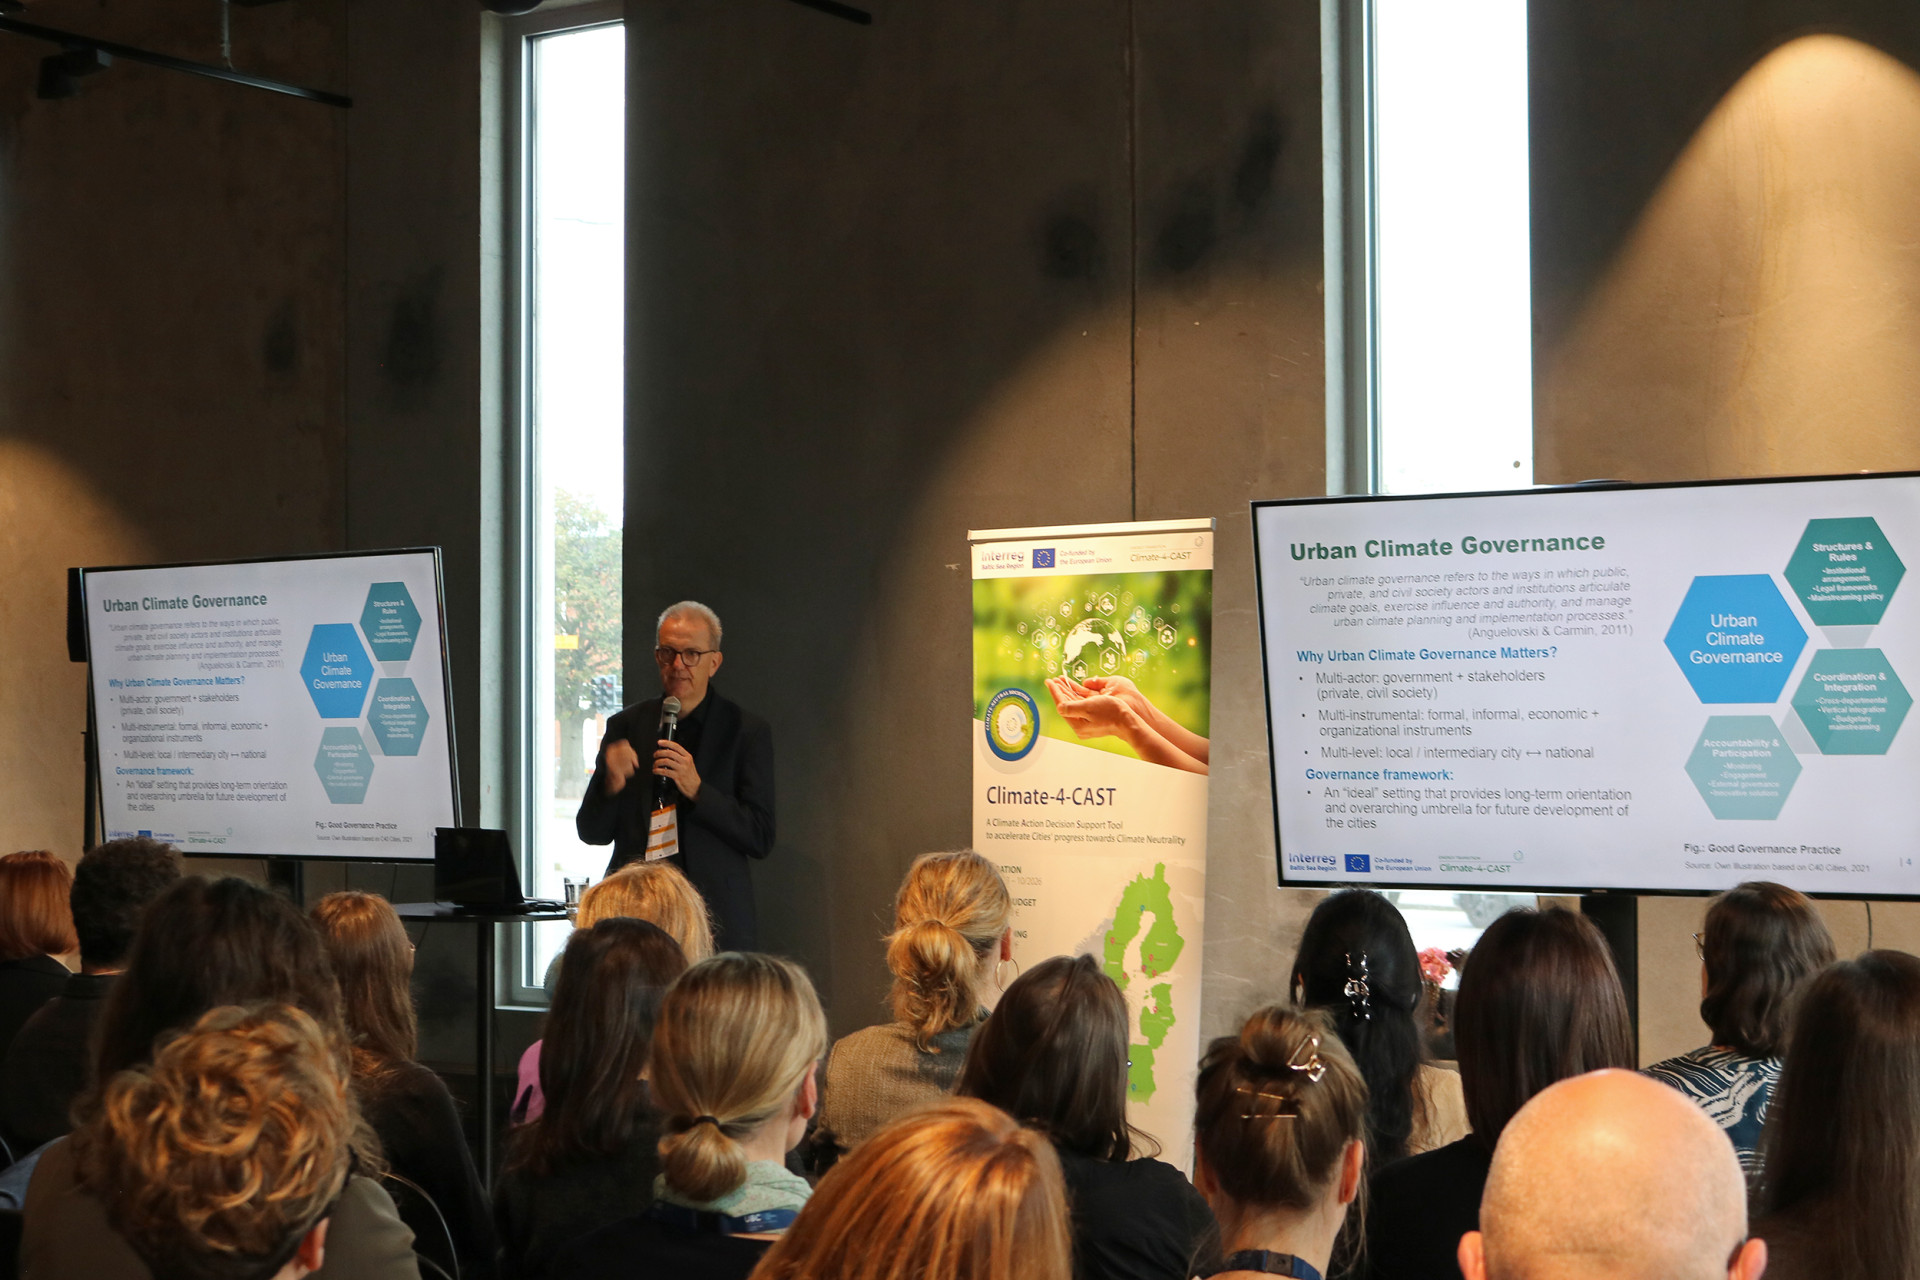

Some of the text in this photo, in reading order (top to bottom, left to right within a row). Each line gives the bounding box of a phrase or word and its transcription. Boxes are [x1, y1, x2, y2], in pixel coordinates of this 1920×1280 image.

[1291, 536, 1605, 561] Urban Climate Governance
[1812, 542, 1873, 552] Structures &
[981, 551, 1024, 562] Interreg
[1130, 551, 1192, 563] Climate-4-CAST
[1829, 553, 1857, 561] Rules
[1338, 576, 1374, 585] climate
[1378, 573, 1440, 586] governance
[1444, 571, 1475, 582] refers
[1478, 572, 1488, 581] to
[1492, 571, 1509, 580] the
[1512, 570, 1540, 582] ways
[1544, 569, 1553, 579] in
[1557, 569, 1589, 579] which
[1370, 588, 1389, 598] and
[1392, 588, 1412, 598] civil
[1415, 586, 1453, 598] society
[1455, 586, 1489, 596] actors
[1493, 584, 1513, 595] and
[1517, 584, 1575, 594] institutions
[1579, 582, 1631, 592] articulate
[103, 595, 267, 612] Urban Climate Governance
[1310, 603, 1346, 614] climate
[1384, 602, 1428, 612] exercise
[1431, 600, 1480, 611] influence
[1484, 600, 1503, 609] and
[1561, 597, 1582, 607] and
[1585, 597, 1631, 609] manage
[1334, 617, 1363, 626] urban
[1367, 616, 1404, 626] climate
[1407, 615, 1452, 627] planning
[1455, 613, 1476, 624] and
[1479, 612, 1565, 625] implementation
[1710, 614, 1757, 627] Urban
[1468, 624, 1633, 640] (Anguelovski & Carmin, 2011)
[1706, 632, 1764, 646] Climate
[323, 653, 347, 662] Urban
[1297, 646, 1557, 664] Why Urban Climate Governance Matters?
[1690, 650, 1783, 664] Governance
[321, 666, 352, 675] Climate
[1814, 673, 1876, 681] Coordination
[109, 679, 123, 689] Why
[125, 679, 144, 687] Urban
[146, 678, 171, 686] Climate
[173, 677, 213, 686] Governance
[313, 679, 362, 689] Governance
[1316, 672, 1379, 684] Multi-actor:
[1383, 671, 1453, 685] government
[1468, 670, 1545, 682] stakeholders
[1317, 687, 1438, 701] (private, civil society)
[1824, 684, 1877, 693] Integration
[1319, 710, 1424, 721] Multi-instrumental:
[1427, 709, 1469, 721] formal,
[1473, 709, 1524, 721] informal,
[1528, 708, 1588, 720] economic
[1320, 725, 1473, 738] organizational instruments
[1704, 739, 1779, 749] Accountability &
[1321, 747, 1382, 758] Multi-level:
[1386, 747, 1412, 758] local
[1423, 747, 1498, 760] intermediary
[1502, 747, 1521, 760] city
[1546, 747, 1594, 758] national
[1712, 749, 1772, 758] Participation
[116, 767, 155, 775] Governance
[1306, 768, 1454, 781] Governance framework:
[986, 785, 1116, 807] Climate-4-CAST
[1324, 787, 1339, 798] An
[1383, 788, 1421, 801] setting
[1425, 788, 1447, 799] that
[1451, 788, 1501, 801] provides
[1505, 788, 1562, 802] long-term
[1567, 788, 1632, 801] orientation
[1325, 803, 1629, 818] and overarching umbrella for future development of
[986, 818, 1123, 830] A Climate Action Decision Support Tool
[1326, 817, 1377, 829] the cities
[994, 832, 1030, 840] accelerate
[1054, 834, 1084, 843] progress
[1086, 834, 1115, 842] towards
[1117, 835, 1144, 843] Climate
[1146, 835, 1186, 845] Neutrality
[1684, 844, 1841, 855] Fig.: Good Governance Practice
[1289, 853, 1336, 865] Interreg
[1406, 857, 1413, 865] by
[1439, 863, 1512, 873] Climate-4-CAST
[1773, 863, 1794, 871] based
